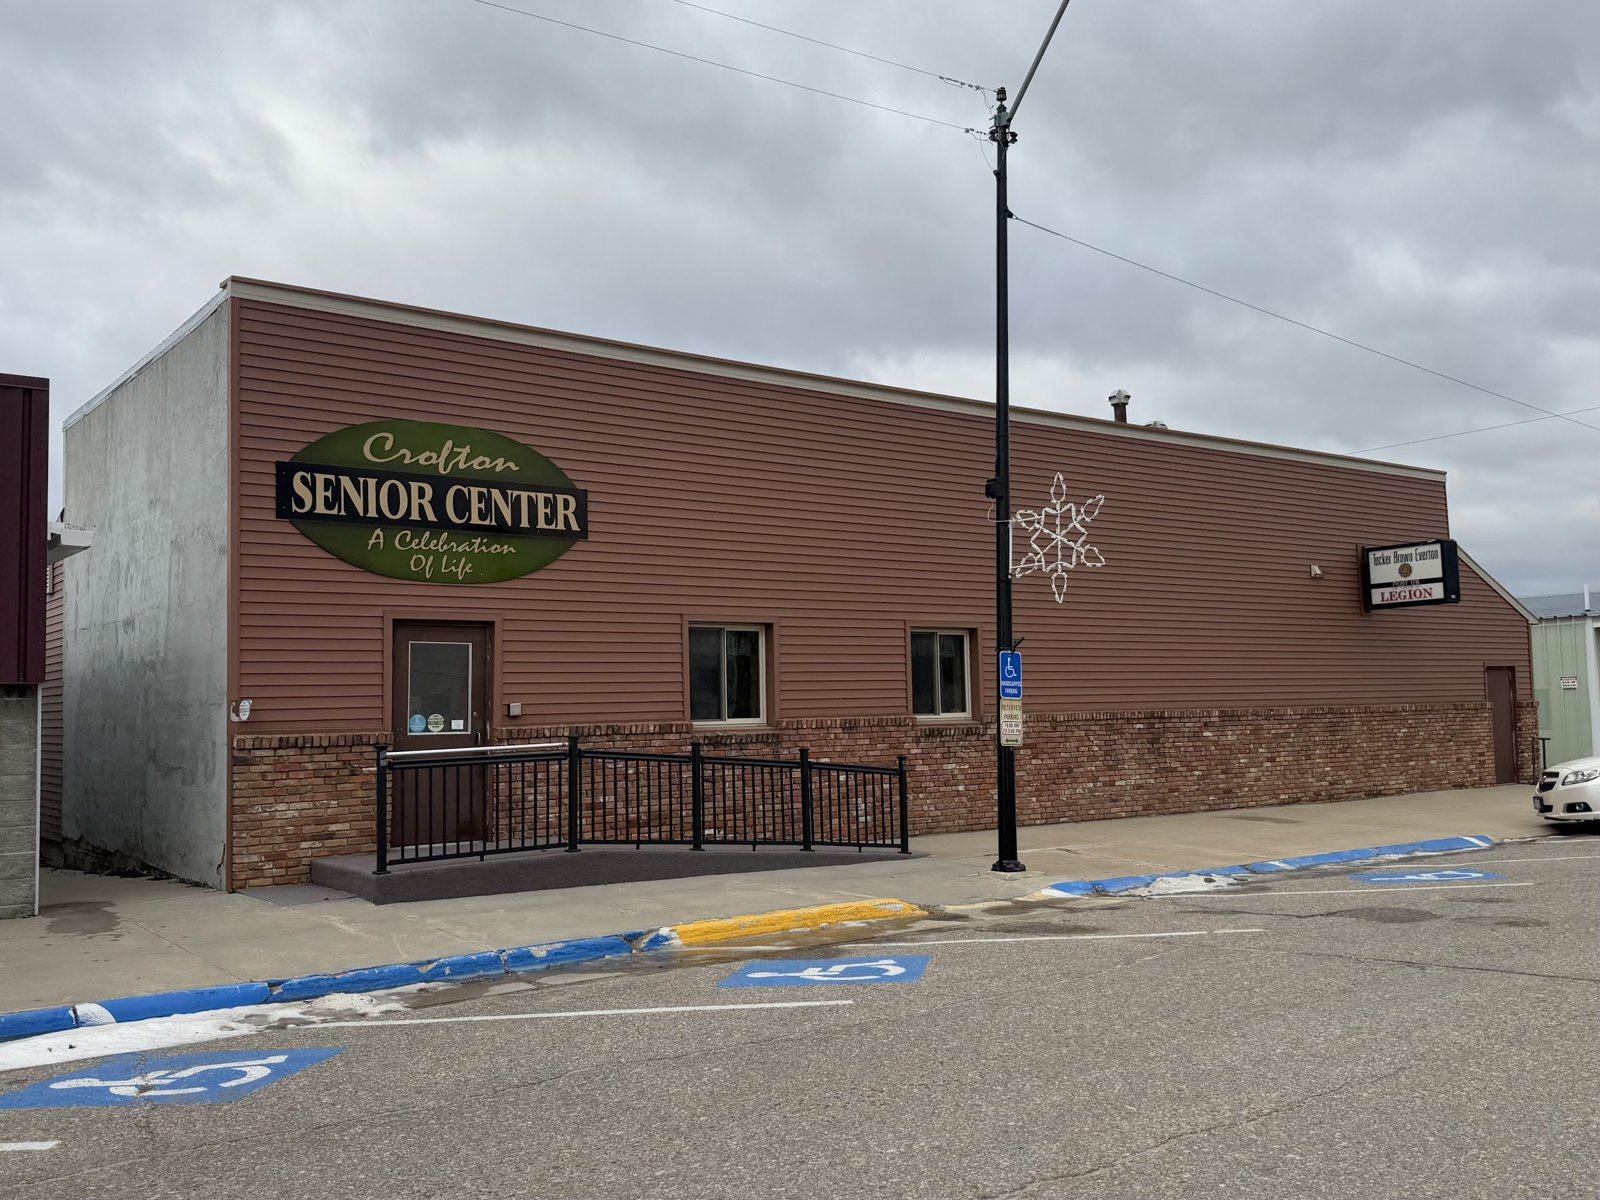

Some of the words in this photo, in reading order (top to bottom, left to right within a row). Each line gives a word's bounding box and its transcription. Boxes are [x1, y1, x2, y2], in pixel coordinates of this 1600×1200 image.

[363, 432, 520, 475] Crofton
[292, 471, 438, 522] SENIOR
[446, 485, 581, 531] CENTER
[368, 528, 384, 551] A
[395, 530, 517, 554] Celebration
[410, 554, 433, 579] Of
[442, 555, 473, 580] Life
[1393, 551, 1413, 564] Brown
[1415, 548, 1438, 562] Everton
[1380, 588, 1433, 602] LEGION
